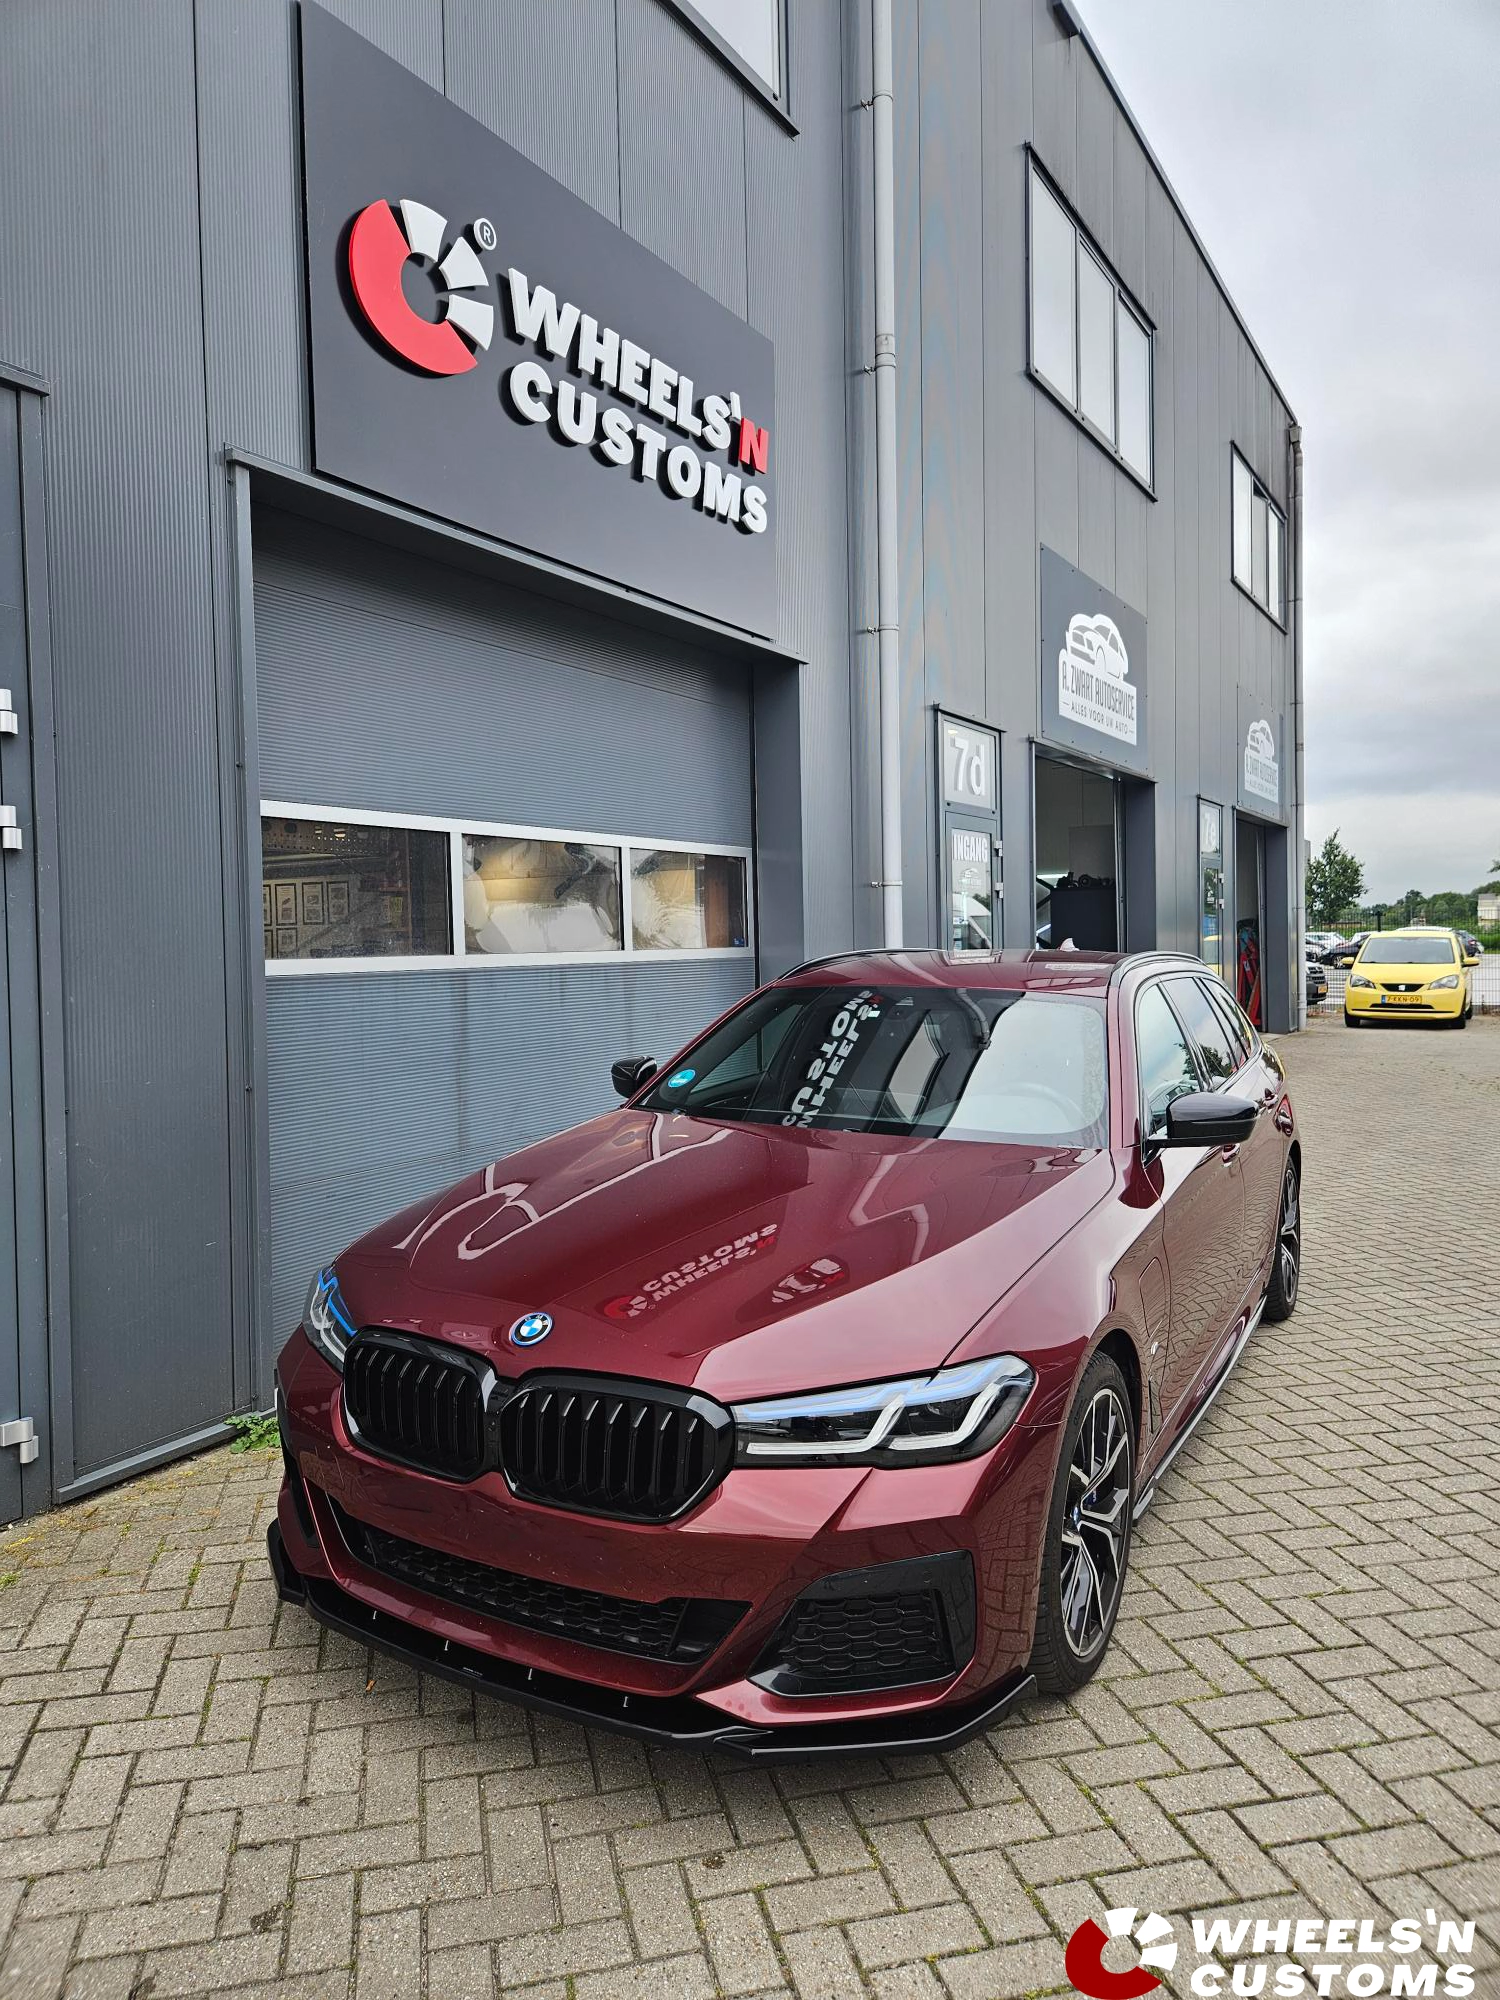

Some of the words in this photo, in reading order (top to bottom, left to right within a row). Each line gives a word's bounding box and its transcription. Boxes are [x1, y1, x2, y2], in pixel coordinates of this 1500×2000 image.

[508, 267, 769, 474] WHEELS'N
[510, 361, 768, 533] CUSTOMS
[1070, 664, 1094, 702] ZWART
[1095, 677, 1134, 721] AUTOSERVICE
[951, 736, 986, 796] 7d
[953, 833, 988, 863] INGANG
